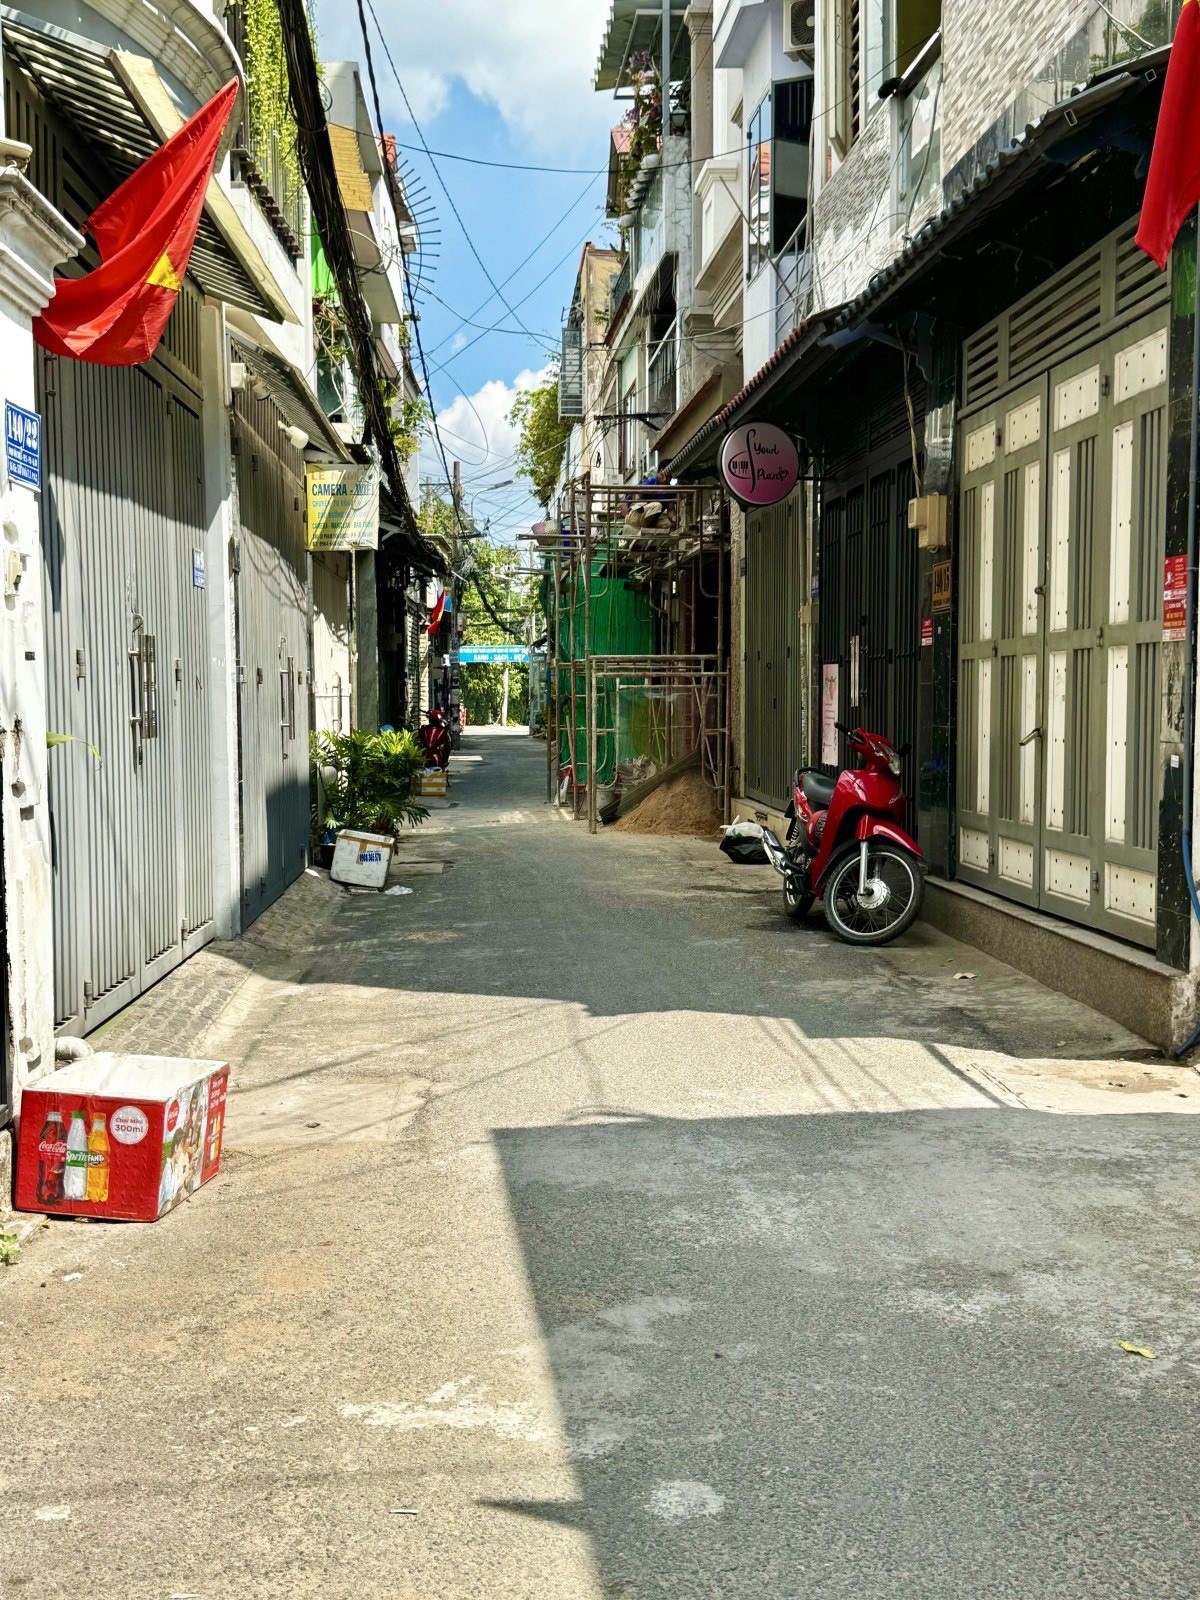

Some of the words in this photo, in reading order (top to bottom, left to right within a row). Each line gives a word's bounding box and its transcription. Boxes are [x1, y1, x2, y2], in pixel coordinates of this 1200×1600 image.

[8, 408, 38, 450] 140/22
[312, 483, 347, 496] CAMERA
[114, 1124, 144, 1133] 300ml
